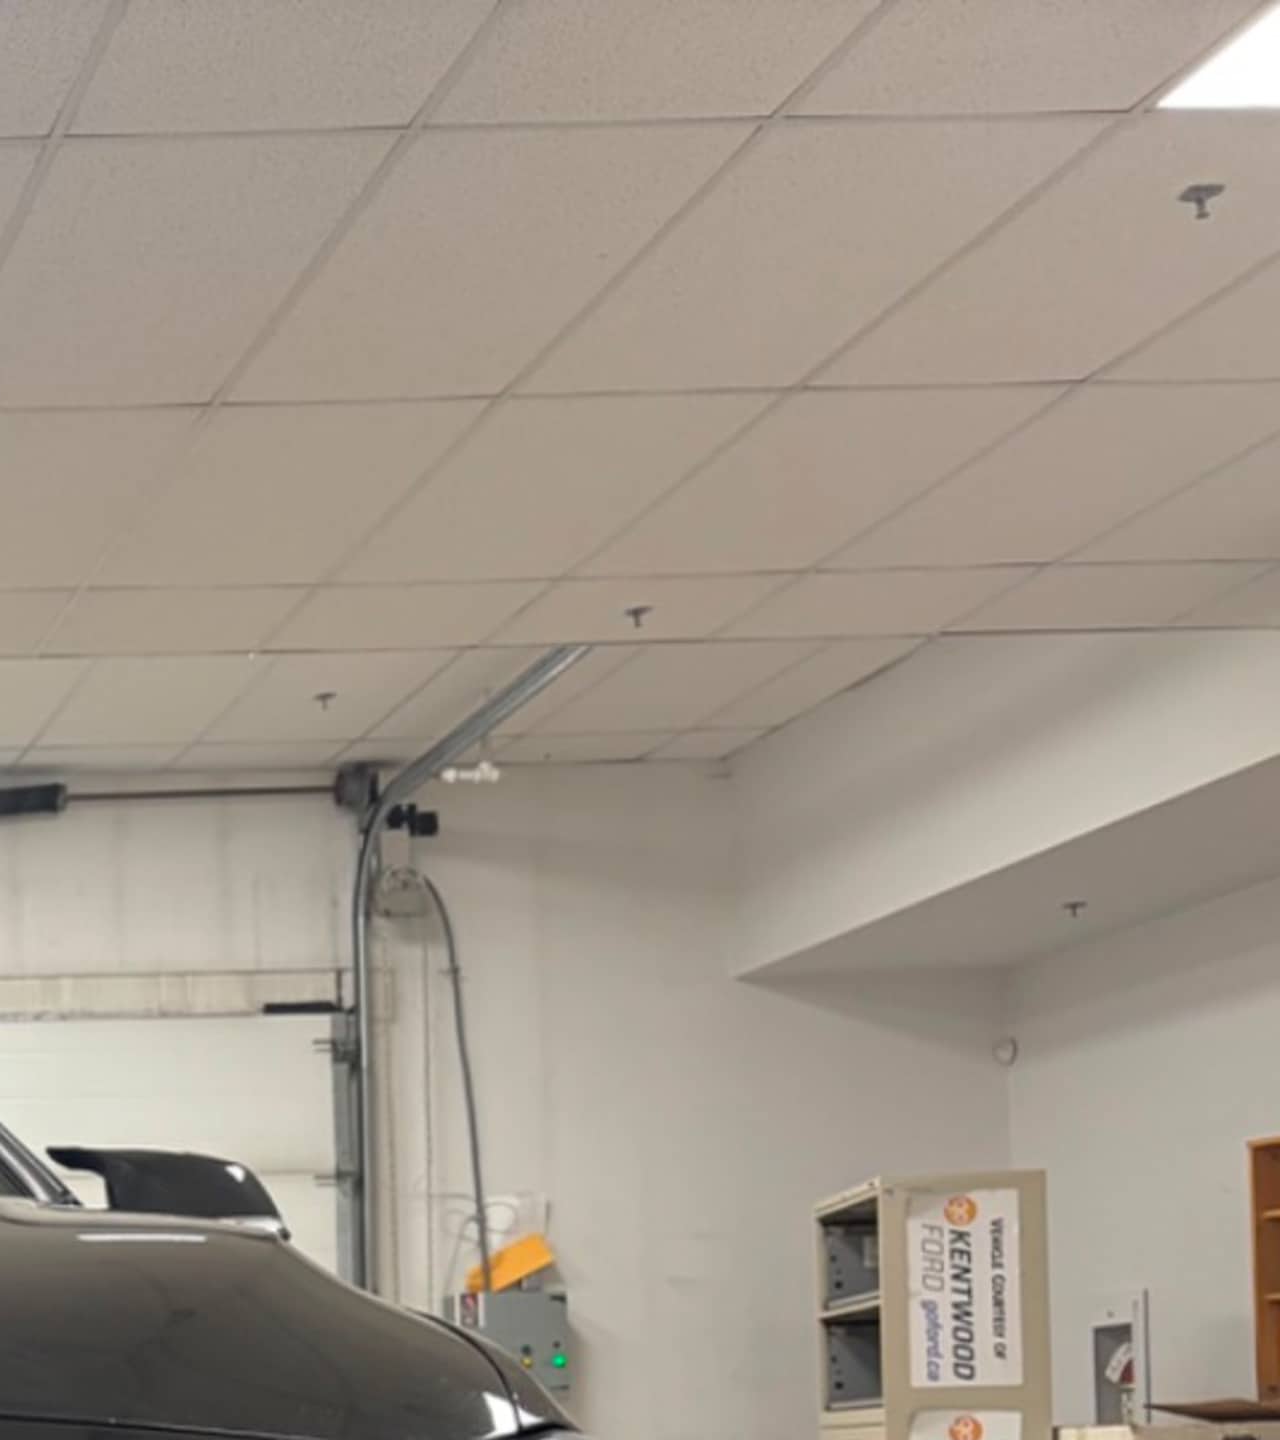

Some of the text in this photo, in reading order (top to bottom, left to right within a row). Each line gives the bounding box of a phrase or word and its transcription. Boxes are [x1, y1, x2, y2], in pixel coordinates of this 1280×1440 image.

[920, 1223, 945, 1293] FORD
[920, 1299, 942, 1382] goford.ca
[948, 1229, 976, 1381] KENTWOOD
